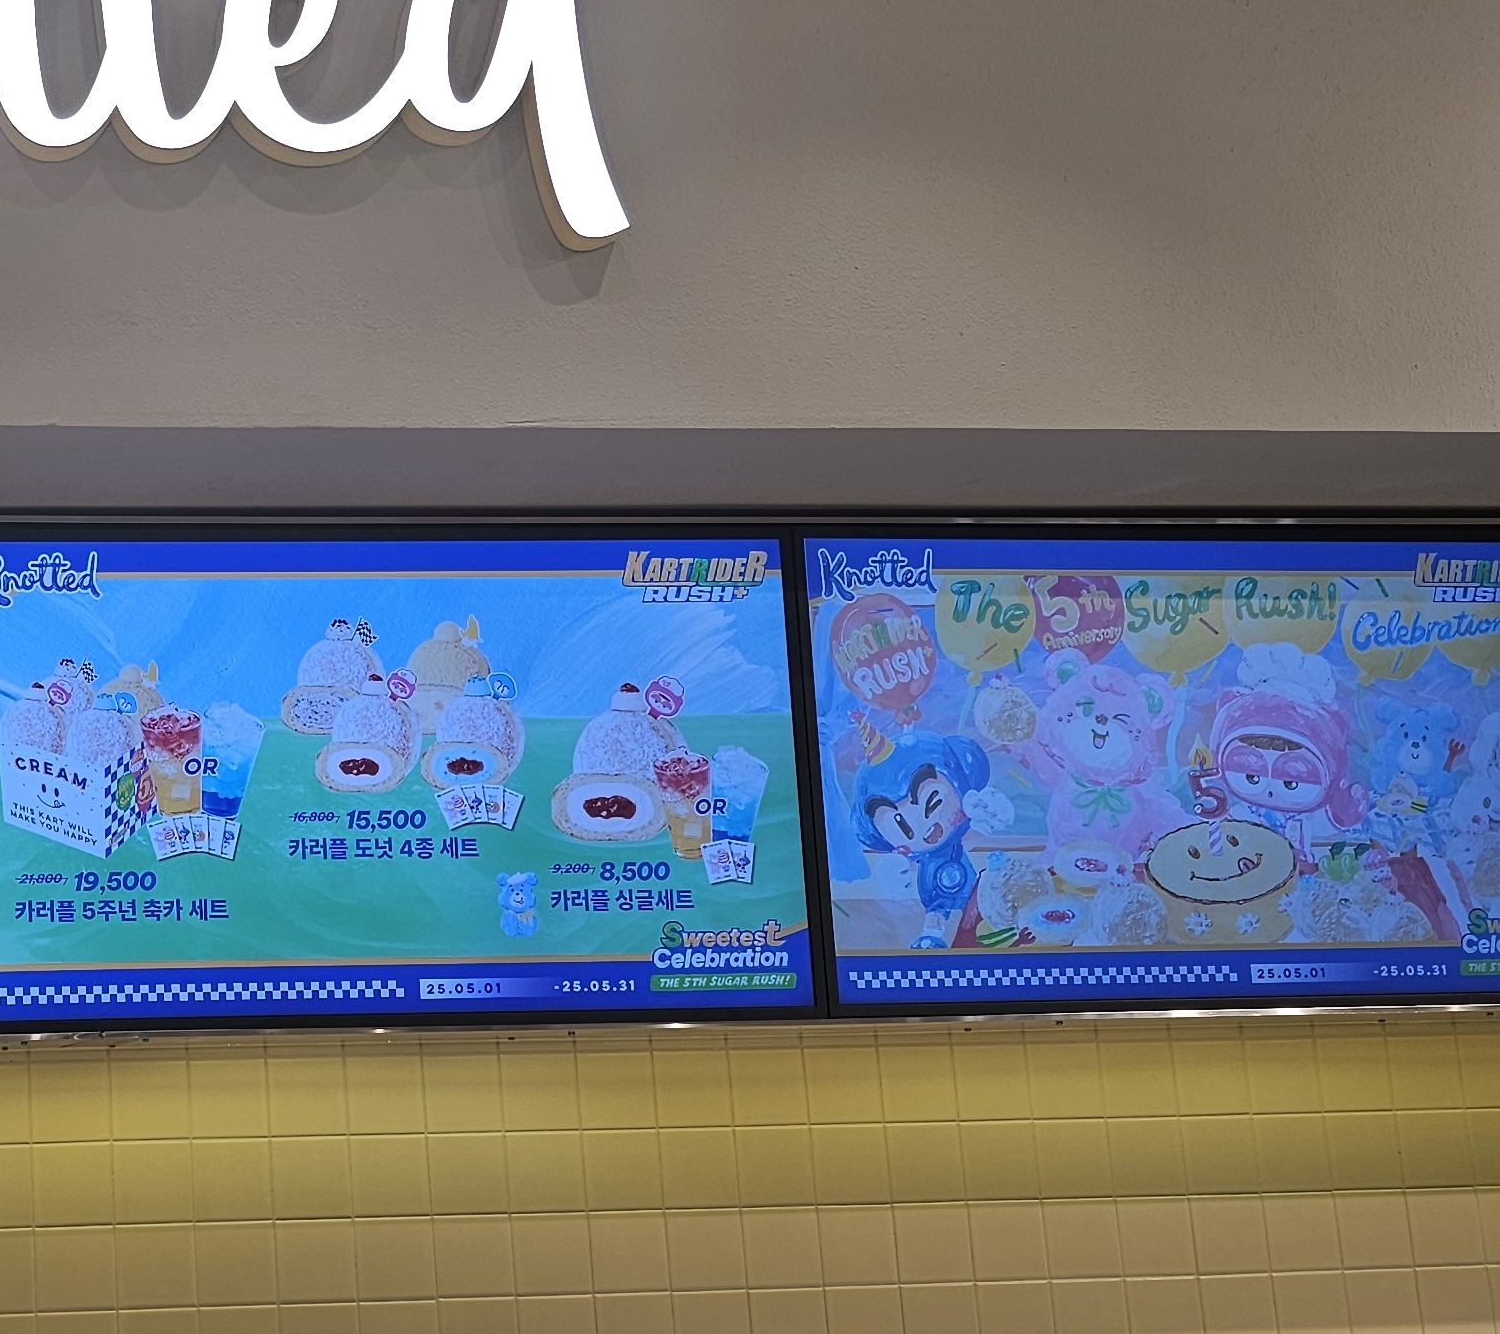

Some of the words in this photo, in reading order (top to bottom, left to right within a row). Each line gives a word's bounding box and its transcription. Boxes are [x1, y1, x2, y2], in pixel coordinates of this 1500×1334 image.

[622, 550, 768, 587] KARTRIDER
[818, 548, 938, 601] Knotted
[951, 580, 1030, 633] The
[1035, 576, 1115, 632] 5th
[1125, 580, 1223, 636] Sugar
[1235, 577, 1336, 621] Rush!
[1042, 626, 1123, 650] Anniversary
[15, 756, 88, 790] CREAM
[183, 757, 219, 776] OR
[695, 798, 727, 816] OR
[10, 810, 36, 825] MAKE
[40, 819, 60, 833] YOU
[63, 826, 98, 846] HAPPY
[13, 802, 35, 817] THIS
[38, 810, 64, 826] KART
[68, 821, 93, 836] WILL
[346, 809, 426, 833] 15,500
[289, 838, 348, 860] 카러플
[354, 837, 393, 859] 도넛
[400, 837, 434, 859] 4종
[440, 837, 479, 859] 세트
[74, 871, 157, 894] 19,500
[600, 862, 670, 885] 8,500
[15, 900, 76, 922] 카러플
[82, 899, 137, 921] 5주년
[143, 899, 183, 921] 축카
[189, 899, 229, 921] 세트
[551, 890, 609, 911] 카러플
[615, 889, 695, 910] 싱글세트
[661, 920, 786, 948] Sweetest
[651, 948, 789, 968] Celebration
[1469, 964, 1486, 972] THE
[660, 978, 680, 988] THE
[683, 977, 706, 988] 5TH
[710, 976, 749, 986] SUGAR
[752, 975, 790, 985] RUSH!
[1257, 968, 1326, 979] 25.05.01
[427, 983, 501, 994] 25.05.01
